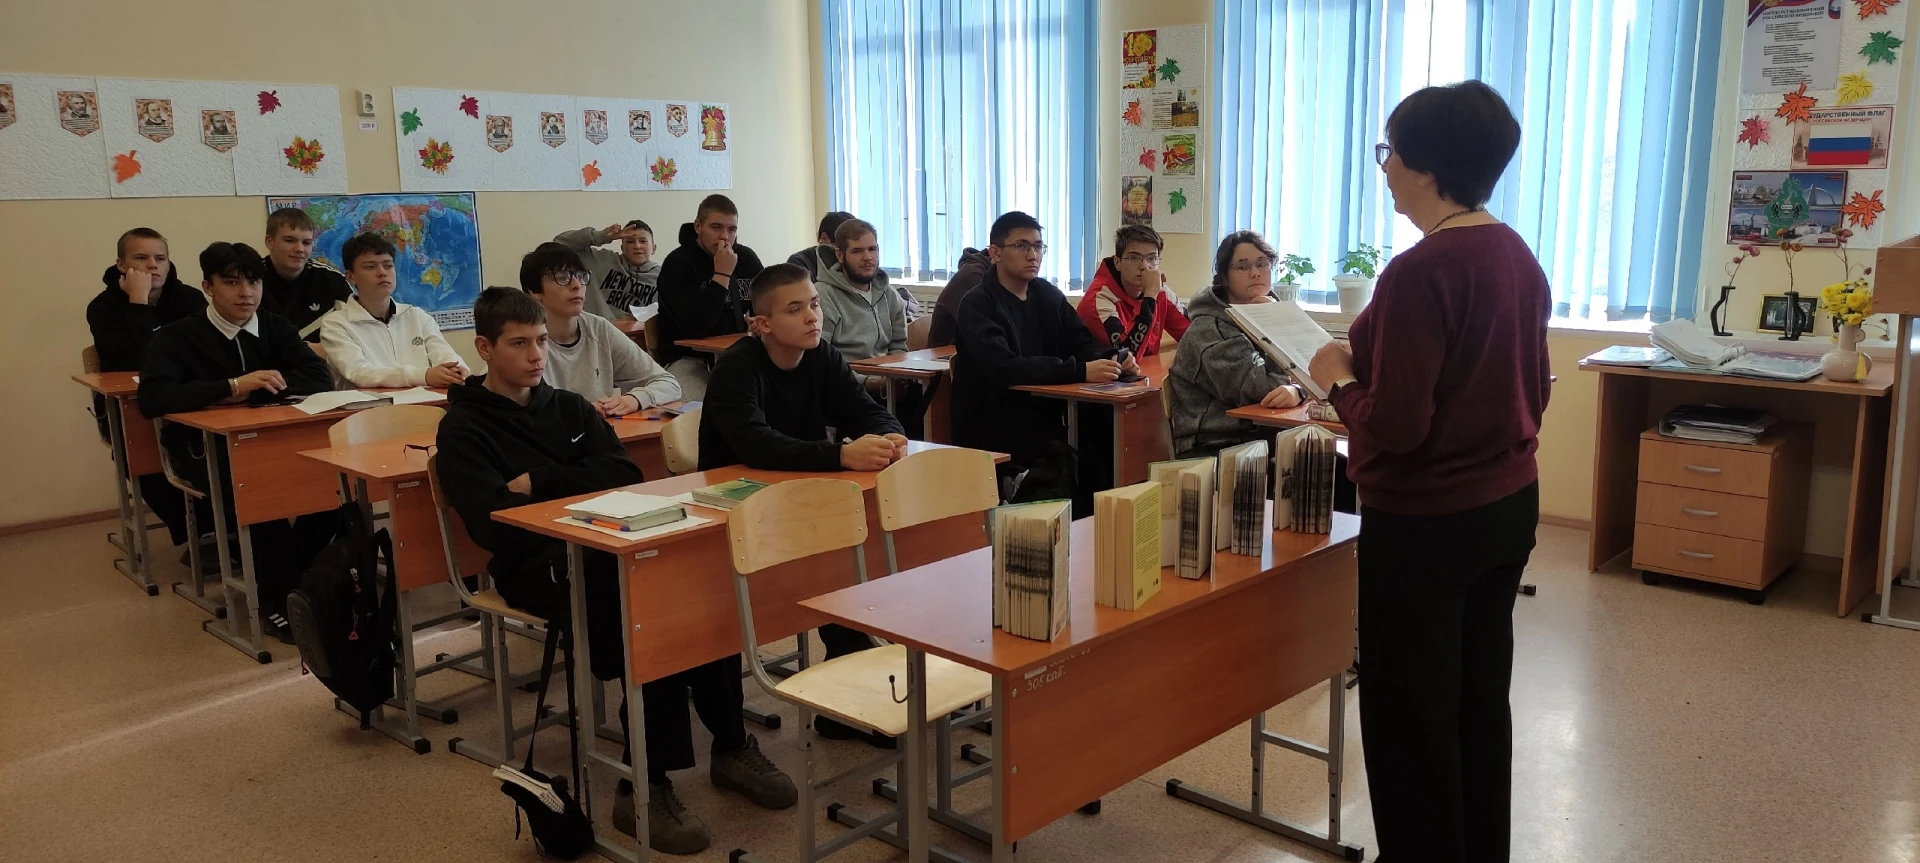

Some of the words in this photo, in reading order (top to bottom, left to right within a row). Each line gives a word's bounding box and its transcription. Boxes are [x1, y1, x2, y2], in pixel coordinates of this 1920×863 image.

[1809, 110, 1866, 119] УДАРСТВЕННЫЙ
[599, 268, 630, 291] NEW
[629, 277, 658, 306] YORK
